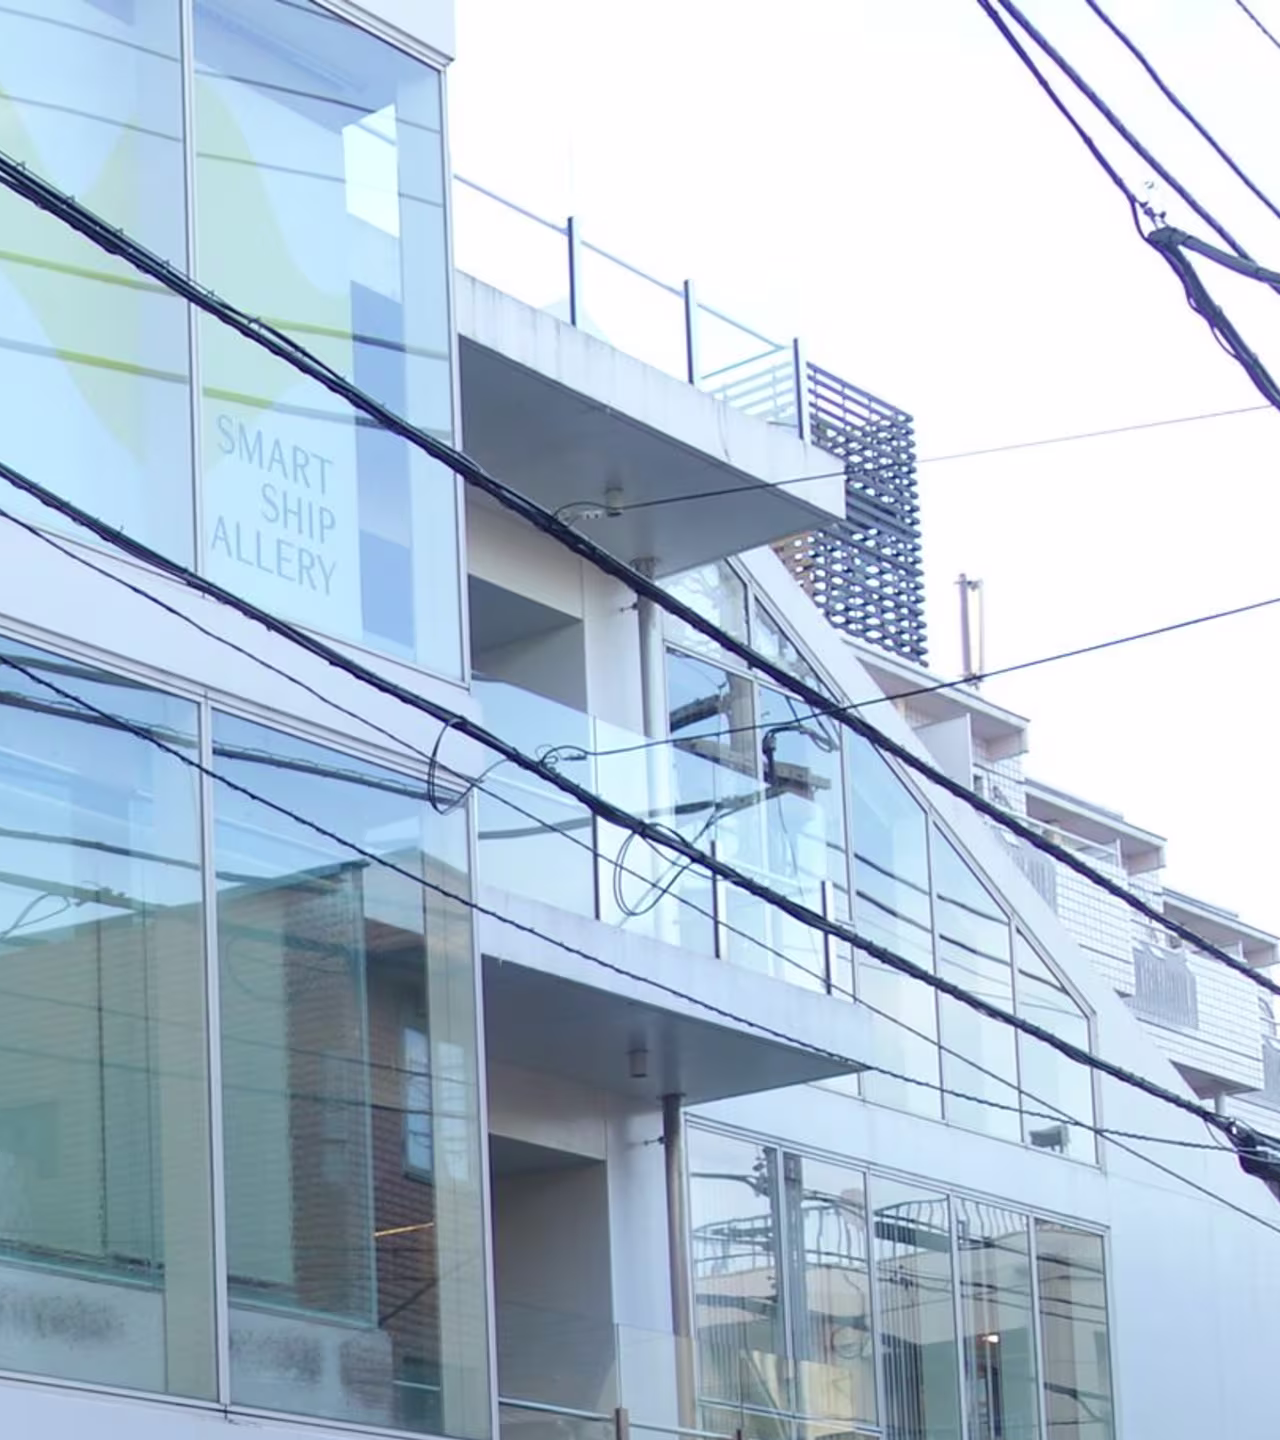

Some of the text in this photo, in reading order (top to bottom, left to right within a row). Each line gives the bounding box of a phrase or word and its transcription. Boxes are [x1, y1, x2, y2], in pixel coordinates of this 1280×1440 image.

[216, 413, 333, 495] SMART
[261, 482, 337, 544] SHIP
[211, 515, 337, 596] ALLERY
